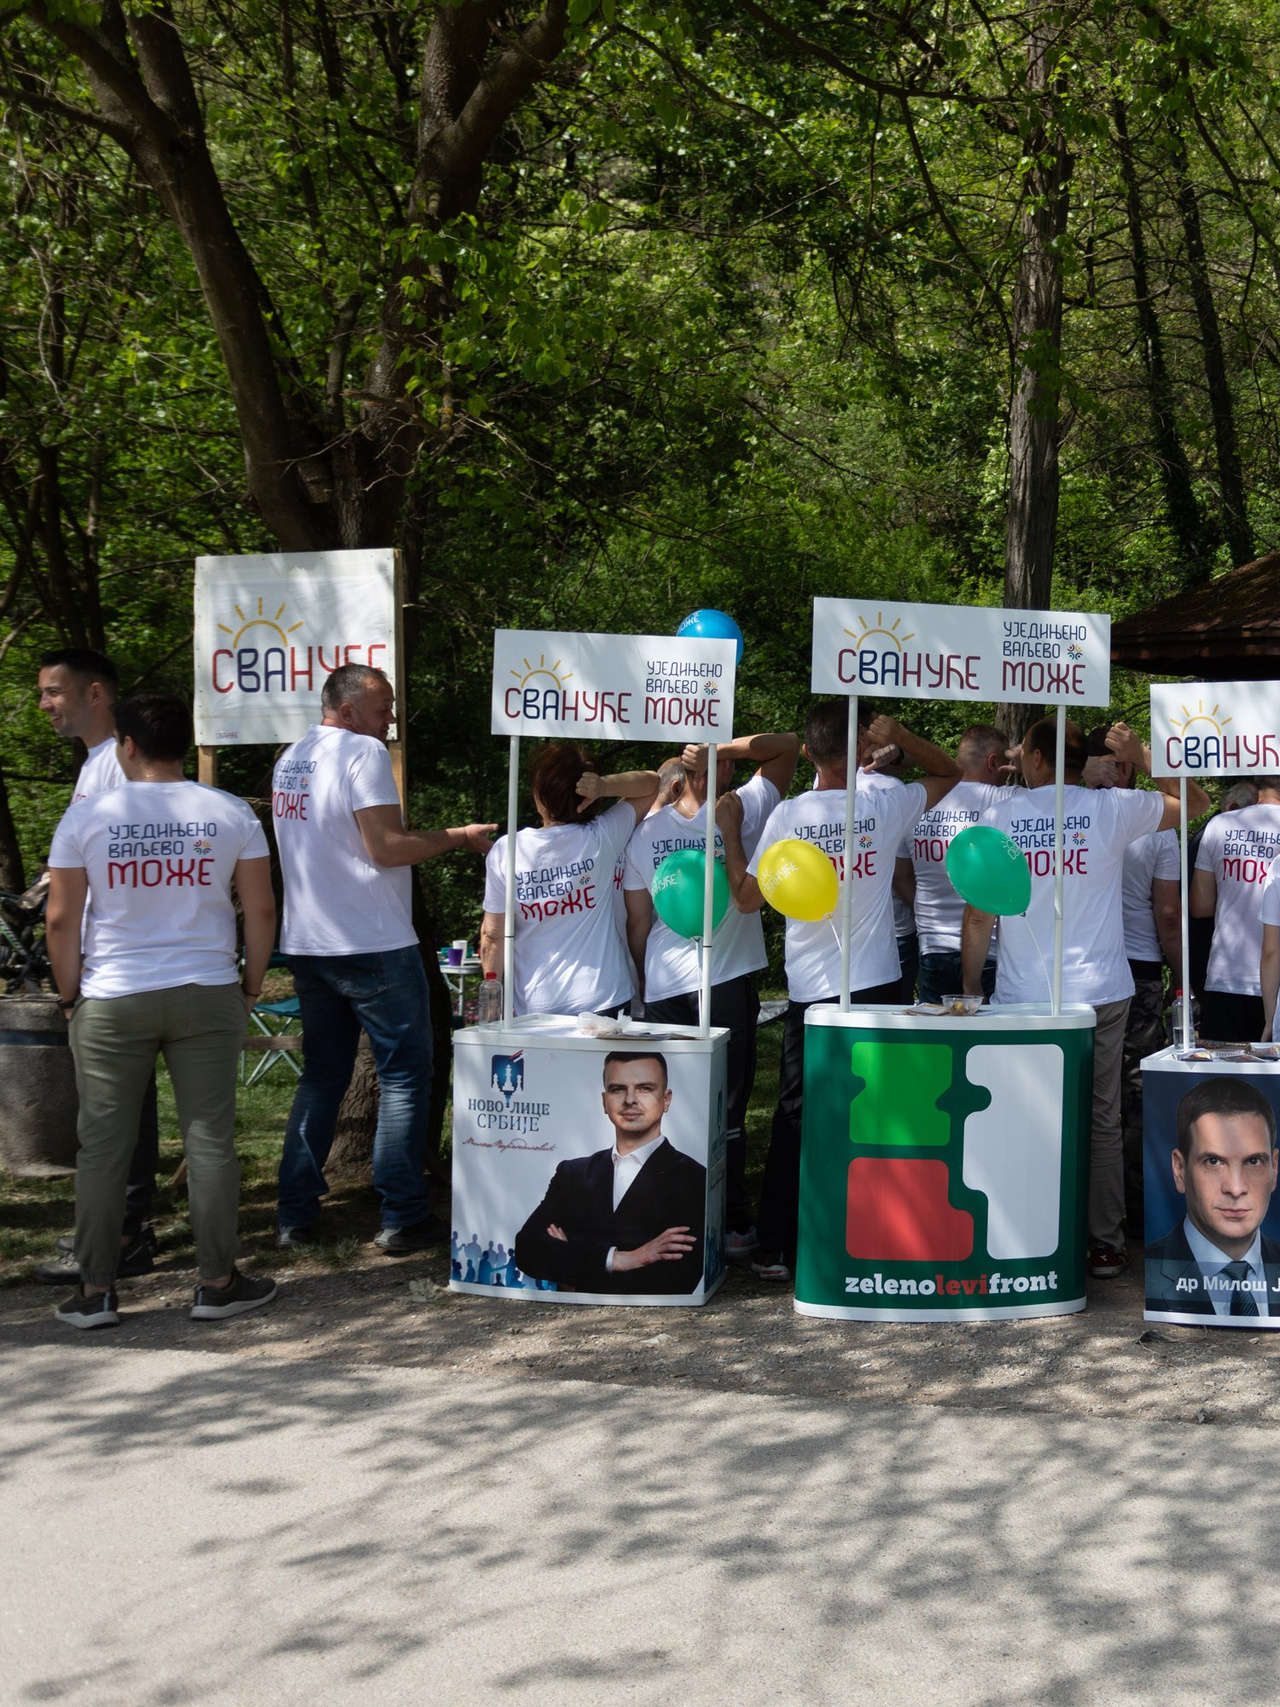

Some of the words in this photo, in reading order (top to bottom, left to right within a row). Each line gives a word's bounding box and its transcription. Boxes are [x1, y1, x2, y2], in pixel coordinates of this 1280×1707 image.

[1003, 621, 1087, 641] УЈЕДИЊЕНО
[1003, 641, 1061, 659] ВАЉЕВО
[647, 661, 723, 678] УЈЕДИЊЕНО
[838, 648, 981, 690] СВАНУЋЕ
[1002, 661, 1086, 695] МОЖЕ
[646, 679, 698, 694] ВАЉЕВО
[504, 687, 632, 723] СВАНУЋЕ
[645, 696, 720, 727] МОЖЕ
[919, 811, 979, 822] ЈЕДИЊЕНО
[109, 822, 217, 840] УЈЕДИЊЕНО
[109, 841, 184, 858] ВАЉЕВО
[1224, 843, 1274, 859] ВАЉЕВО
[108, 858, 215, 889] МОЖЕ
[515, 858, 595, 885] УЈЕДИЊЕНО
[517, 880, 574, 901] ВАЉЕВО
[520, 885, 597, 922] МОЖЕ
[468, 1098, 504, 1113] НОВО
[510, 1101, 550, 1117] ЛИЦЕ
[477, 1114, 540, 1134] СРБИЈЕ
[845, 1270, 1058, 1295] zelenolevifront
[1176, 1277, 1198, 1293] др
[1203, 1276, 1267, 1292] Милош
